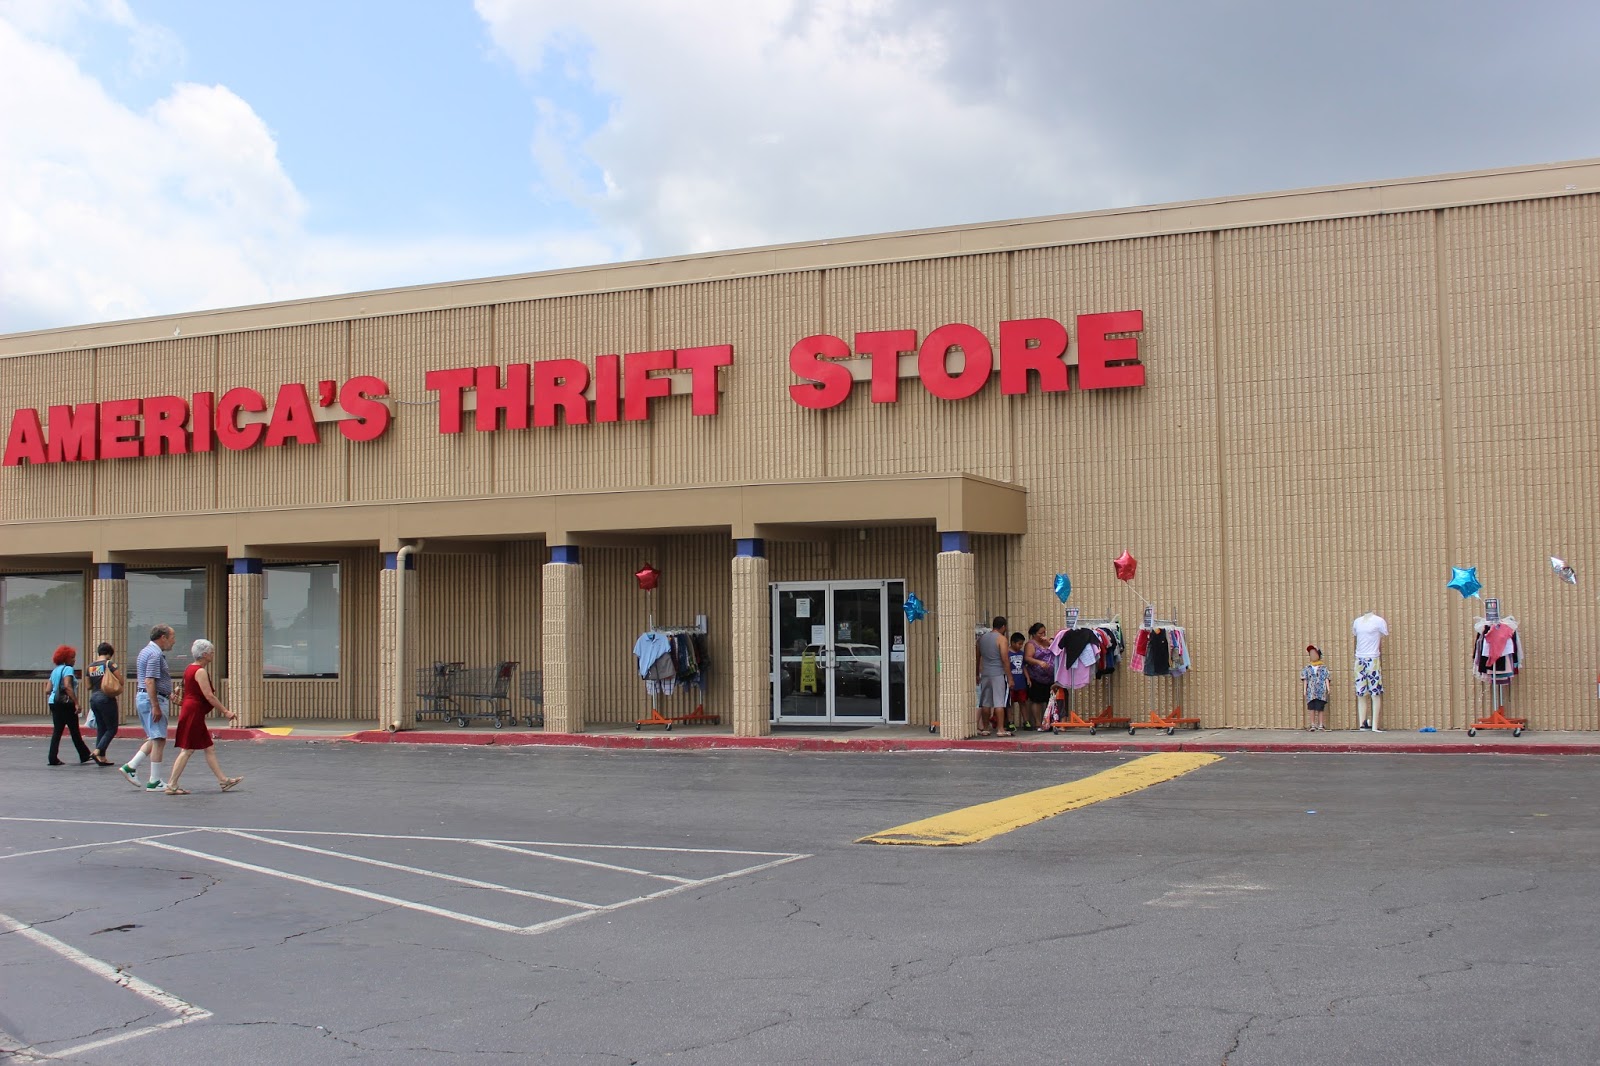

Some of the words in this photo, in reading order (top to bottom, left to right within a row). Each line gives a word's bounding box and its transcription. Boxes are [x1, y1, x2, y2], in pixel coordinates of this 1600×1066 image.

[2, 375, 391, 467] AMERICA'S
[426, 344, 733, 434] THRIFT
[789, 310, 1145, 410] STORE
